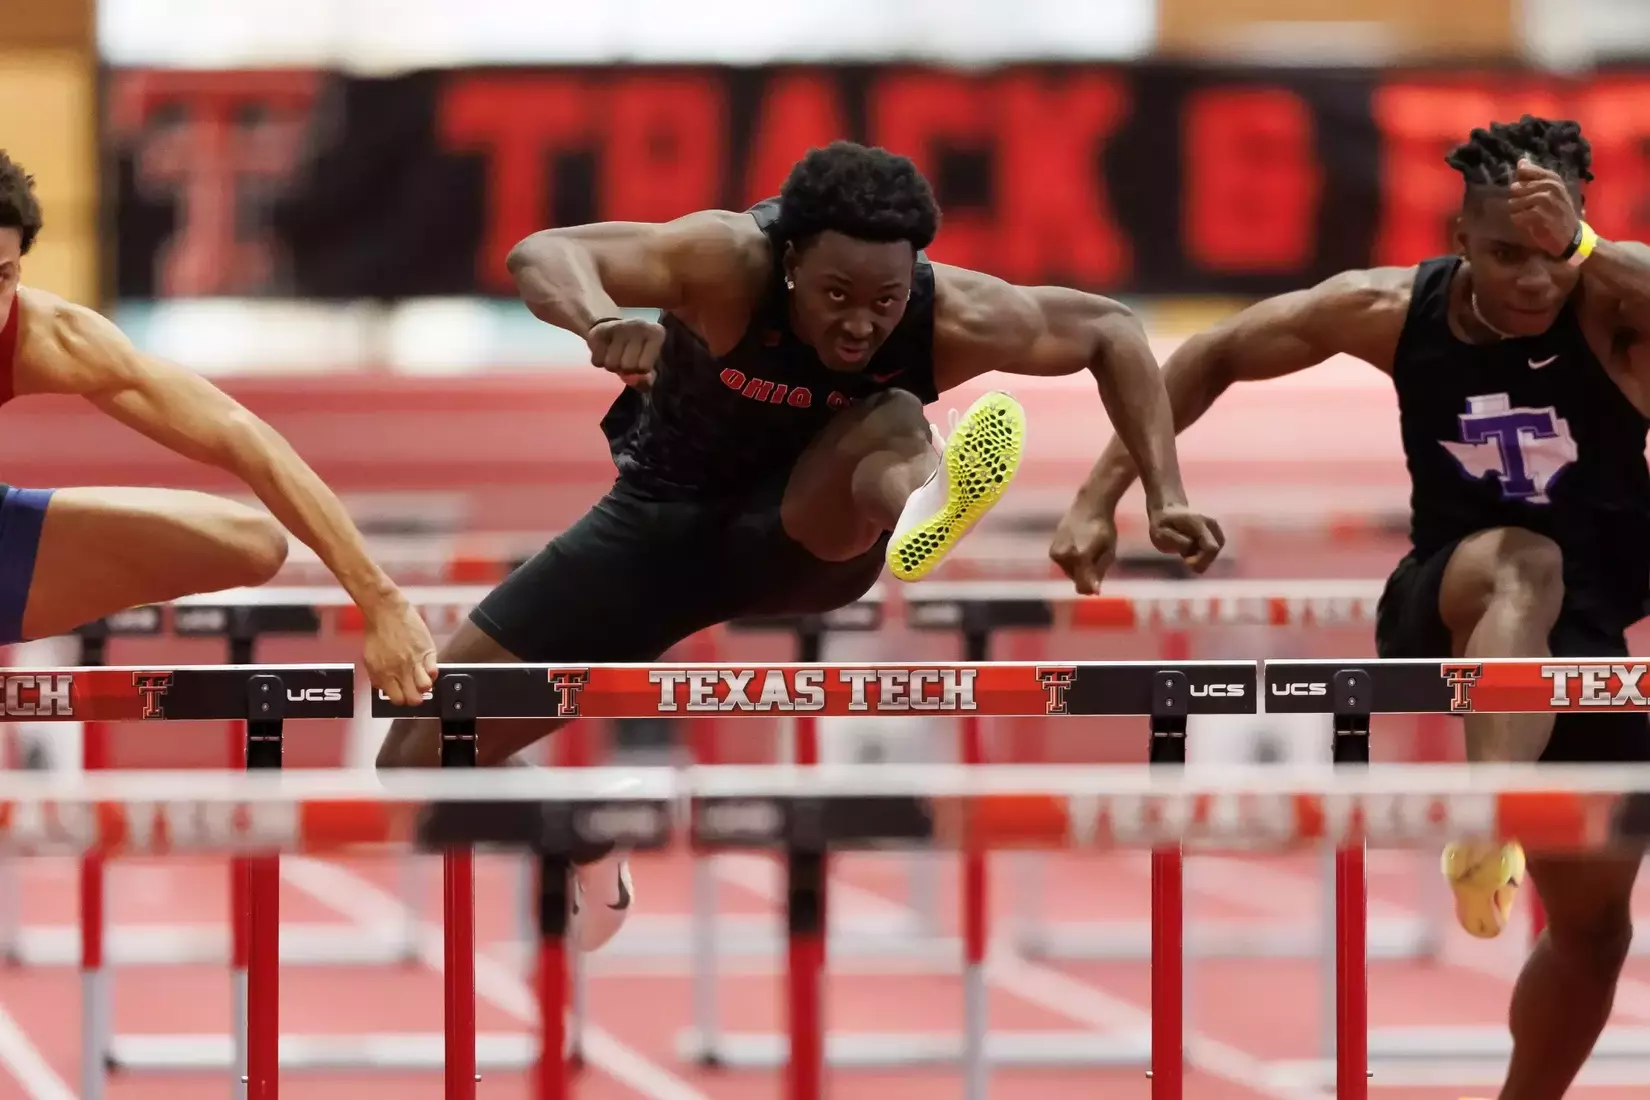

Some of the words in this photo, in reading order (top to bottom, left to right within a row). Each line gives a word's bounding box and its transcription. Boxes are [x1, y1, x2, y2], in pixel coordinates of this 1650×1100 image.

[719, 367, 812, 408] OHIO
[0, 674, 73, 716] CH
[286, 688, 342, 701] UCS
[648, 669, 825, 711] TEXAS
[839, 669, 977, 711] TECH
[1190, 684, 1246, 697] UCS
[1271, 682, 1328, 696] UCS
[1541, 664, 1650, 706] TEX
